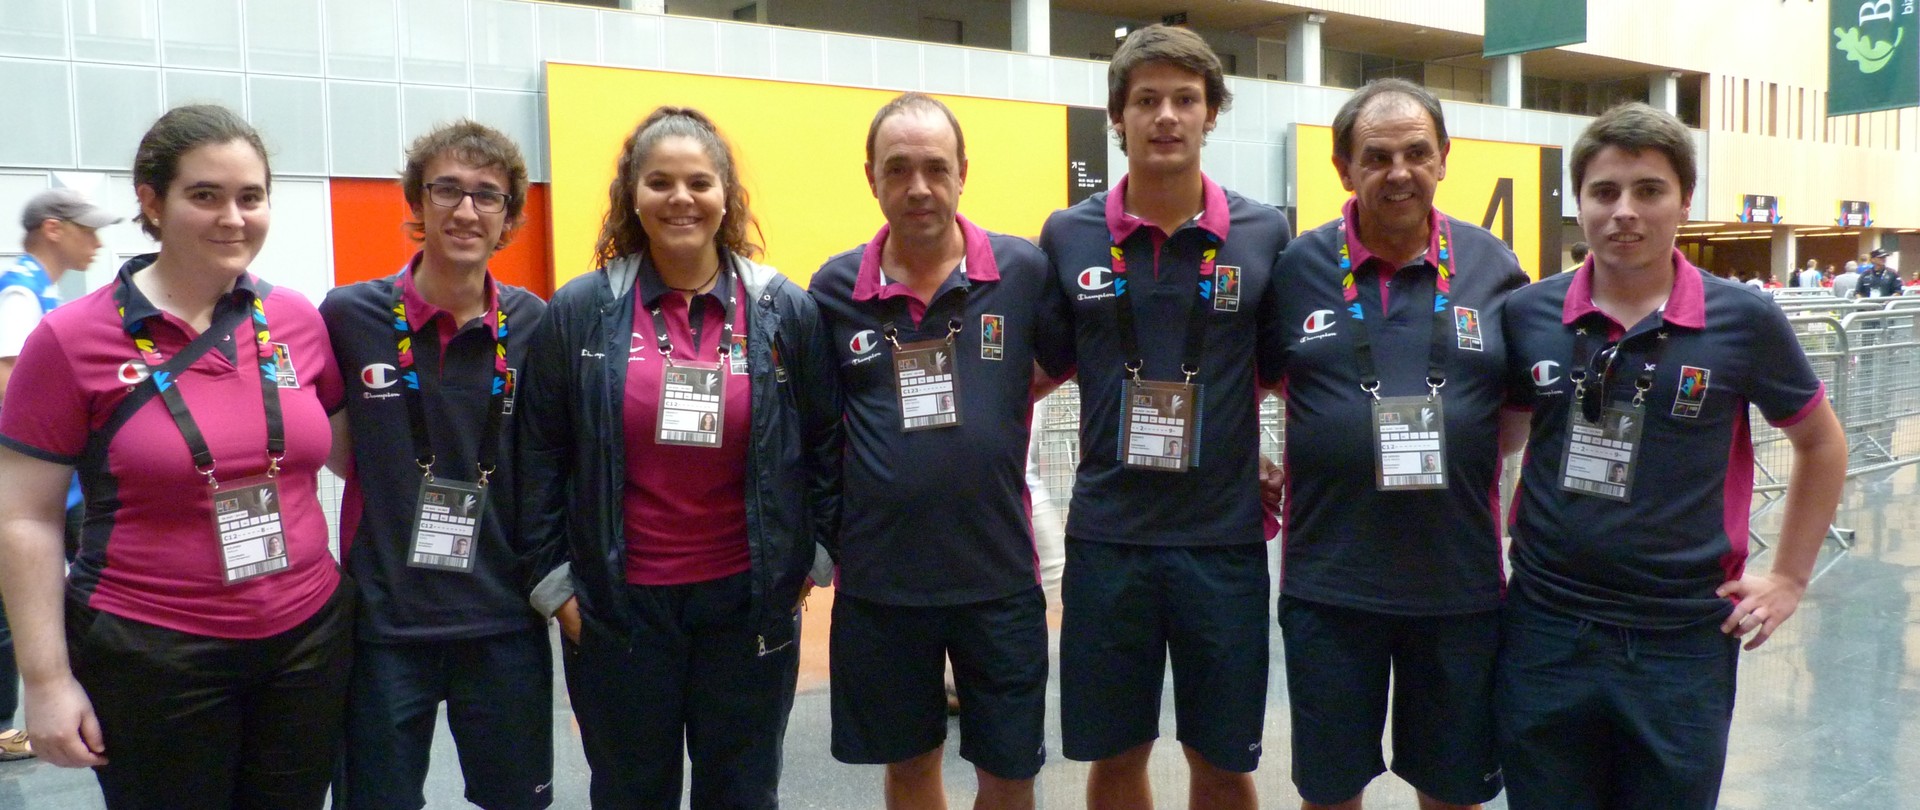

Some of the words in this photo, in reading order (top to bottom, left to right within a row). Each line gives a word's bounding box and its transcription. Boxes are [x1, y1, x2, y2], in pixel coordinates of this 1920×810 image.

[1077, 293, 1116, 301] Champion
[852, 352, 882, 365] Champion
[363, 391, 400, 400] Champion
